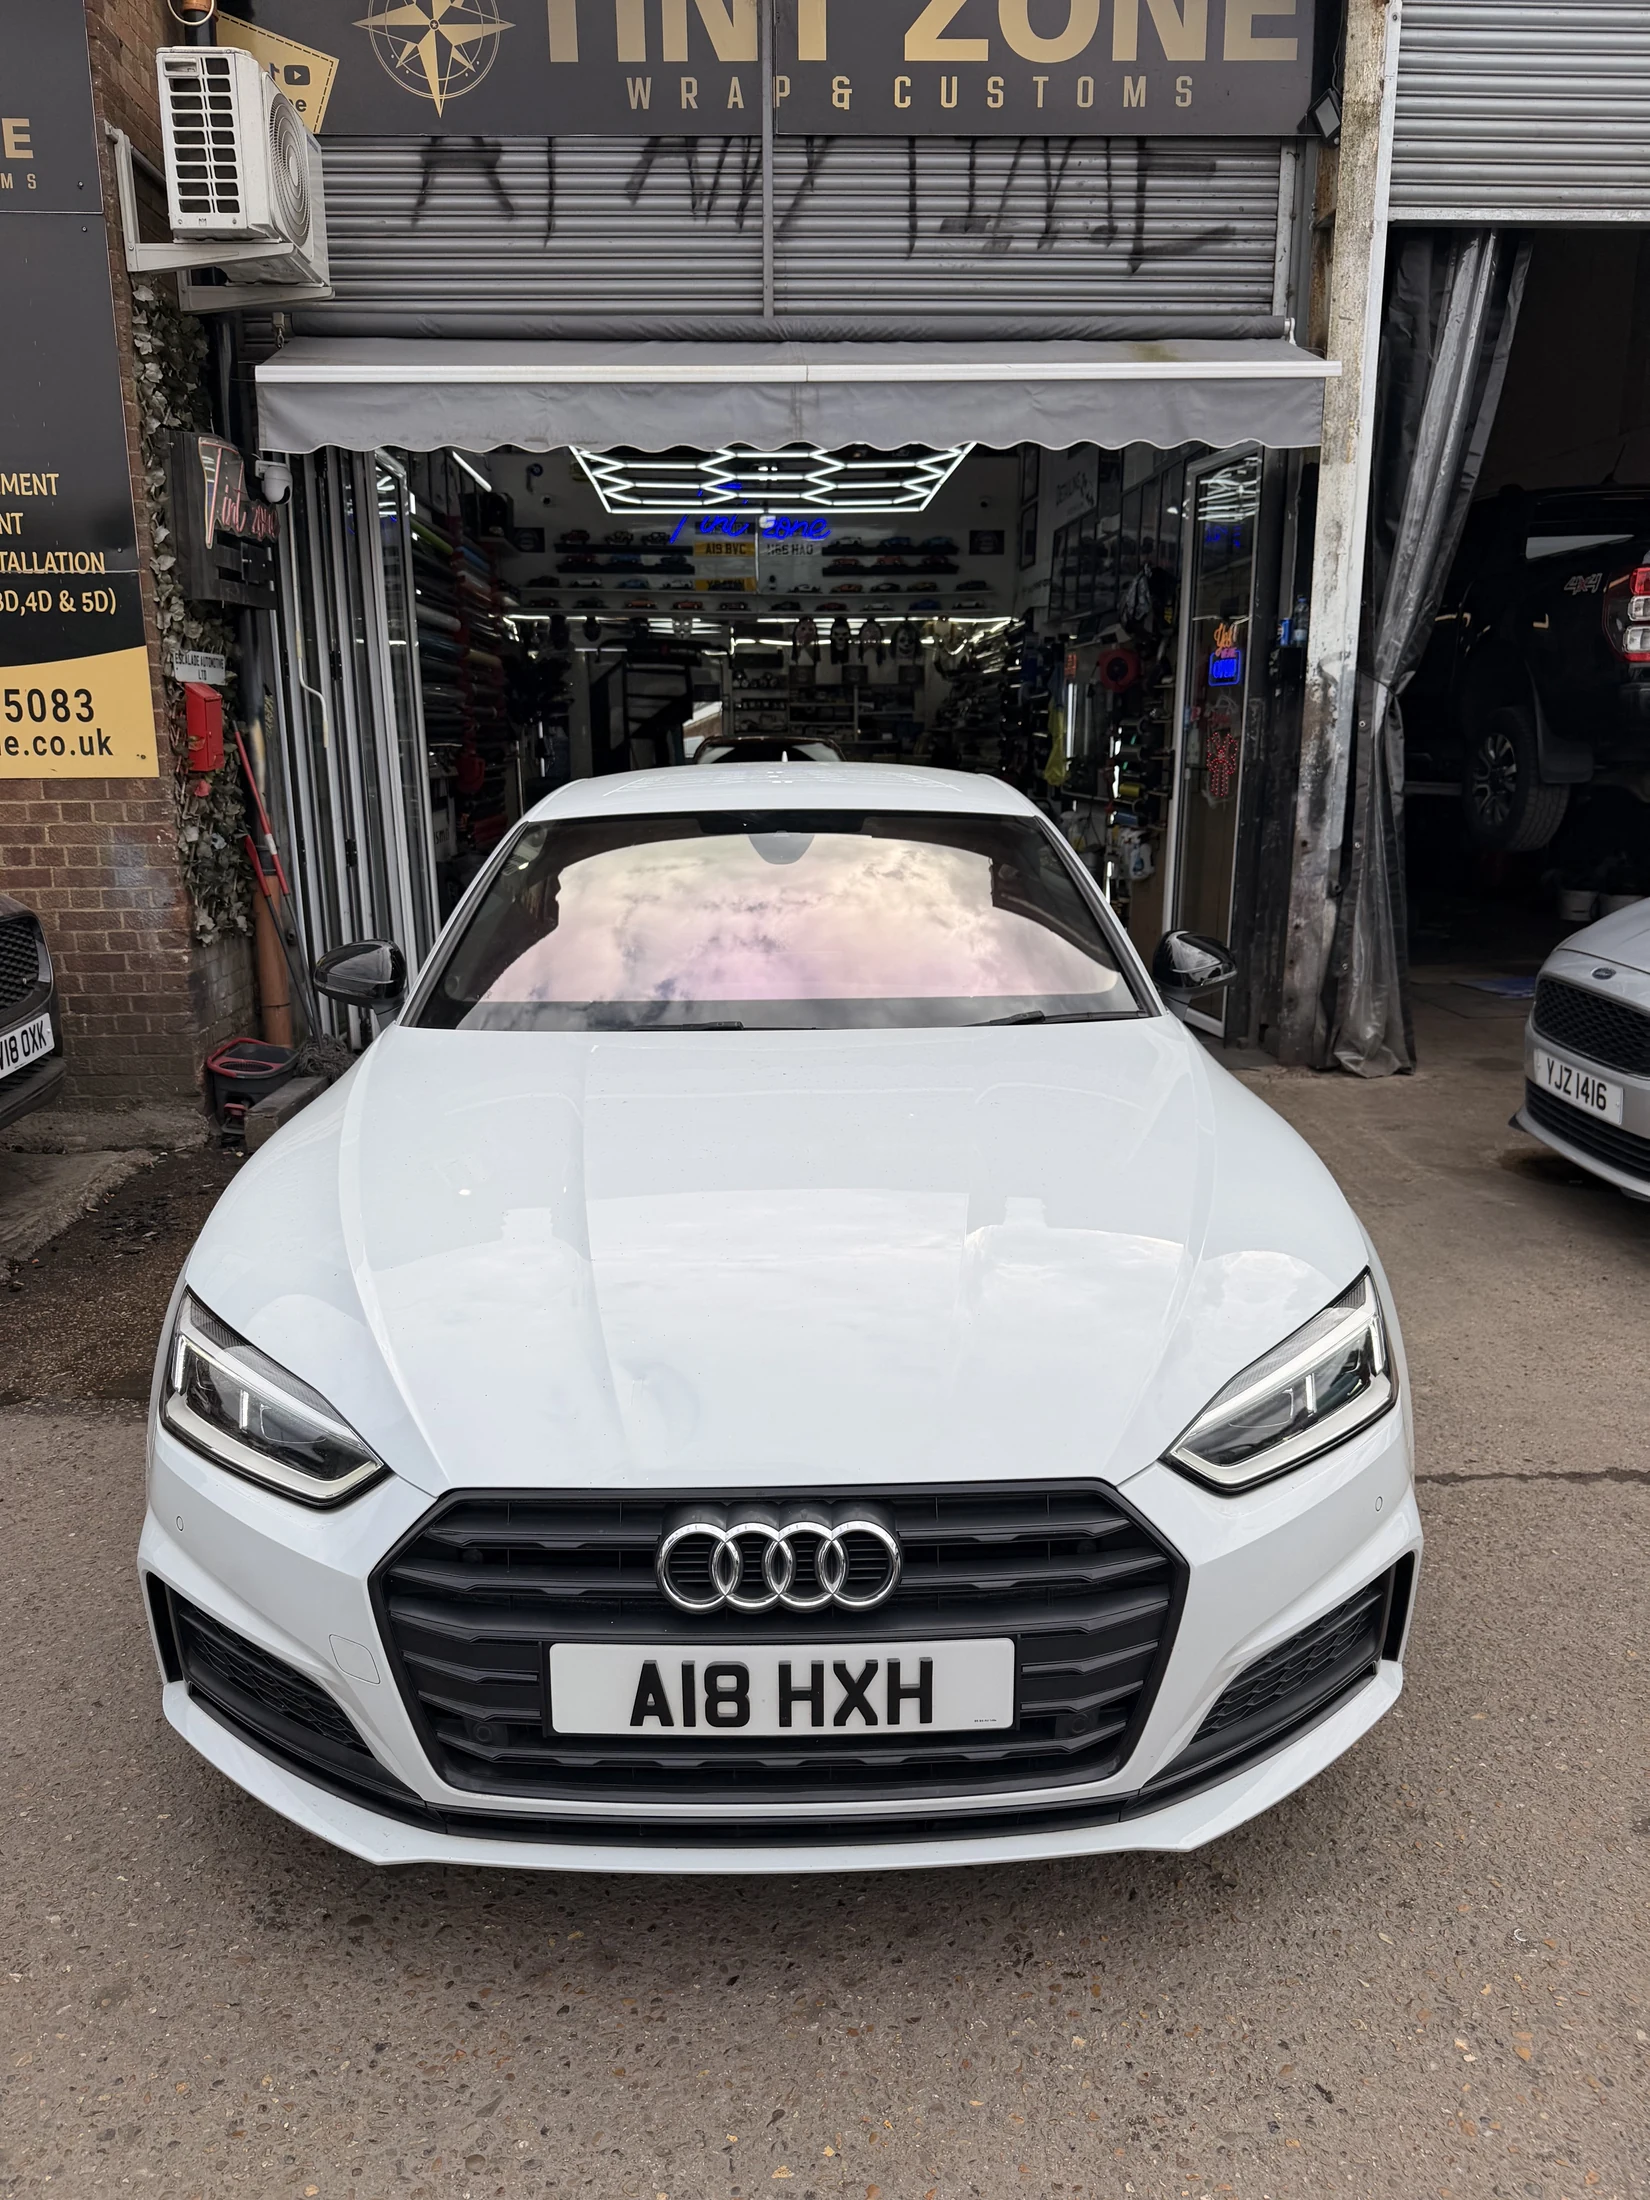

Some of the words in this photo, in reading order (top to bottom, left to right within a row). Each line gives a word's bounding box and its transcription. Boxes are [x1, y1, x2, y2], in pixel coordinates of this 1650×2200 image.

[903, 0, 1299, 64] ZONE
[625, 75, 791, 110] WRAP
[831, 75, 853, 110] &
[893, 75, 1194, 109] CUSTOMS
[0, 472, 60, 497] MENT
[59, 589, 77, 613] &
[82, 587, 117, 616] 5D)
[3, 687, 95, 723] 5083
[0, 727, 114, 757] e.co.uk
[1546, 1057, 1573, 1096] YJZ
[1575, 1072, 1607, 1111] 1416
[629, 1658, 751, 1729] A18
[778, 1655, 934, 1727] HXH
